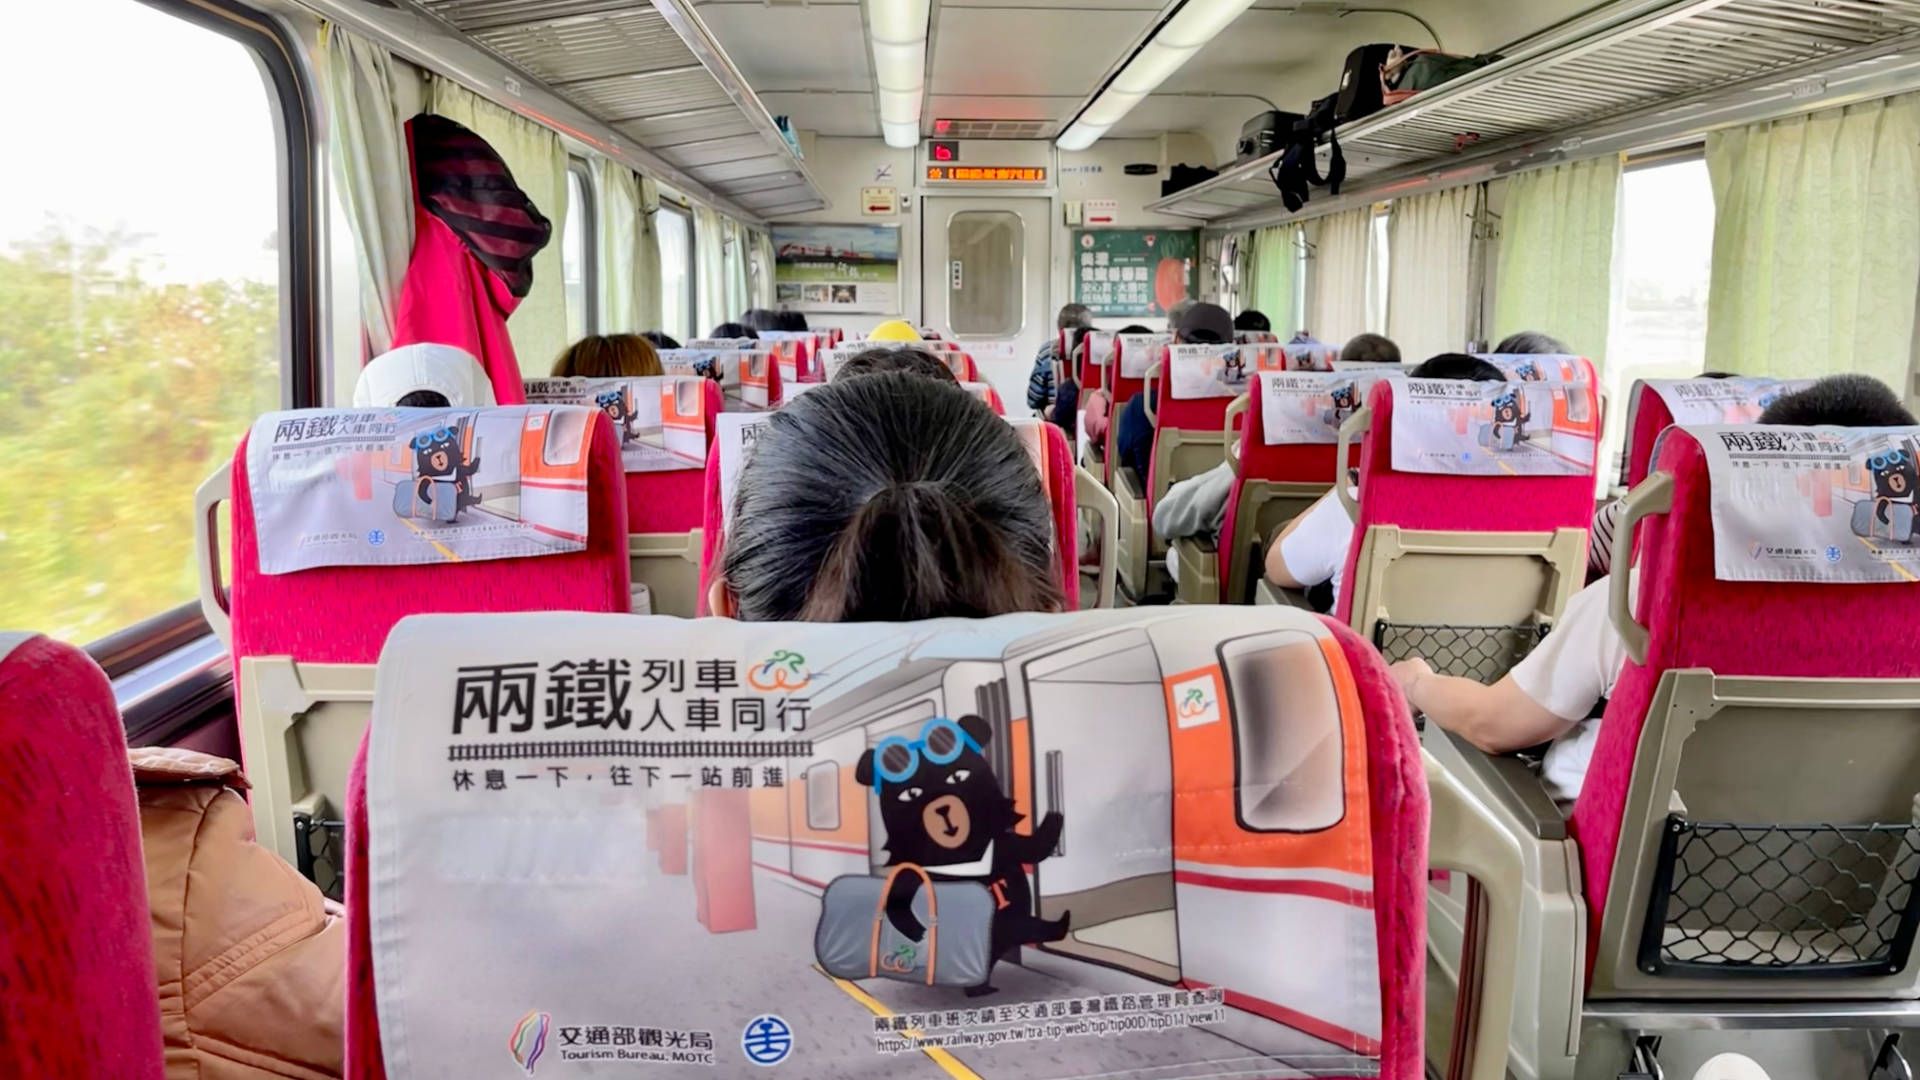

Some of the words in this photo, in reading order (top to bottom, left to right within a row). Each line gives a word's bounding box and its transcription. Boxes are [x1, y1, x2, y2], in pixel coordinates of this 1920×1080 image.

[274, 414, 338, 443] 兩鐵
[1717, 431, 1787, 452] 兩鐵
[450, 657, 632, 735] 兩鐵
[641, 658, 740, 694] 列車
[640, 696, 813, 733] 人車同行
[559, 1026, 713, 1050] 交通部觀光局
[561, 1049, 614, 1061] Tourism
[671, 1052, 713, 1064] MOTC
